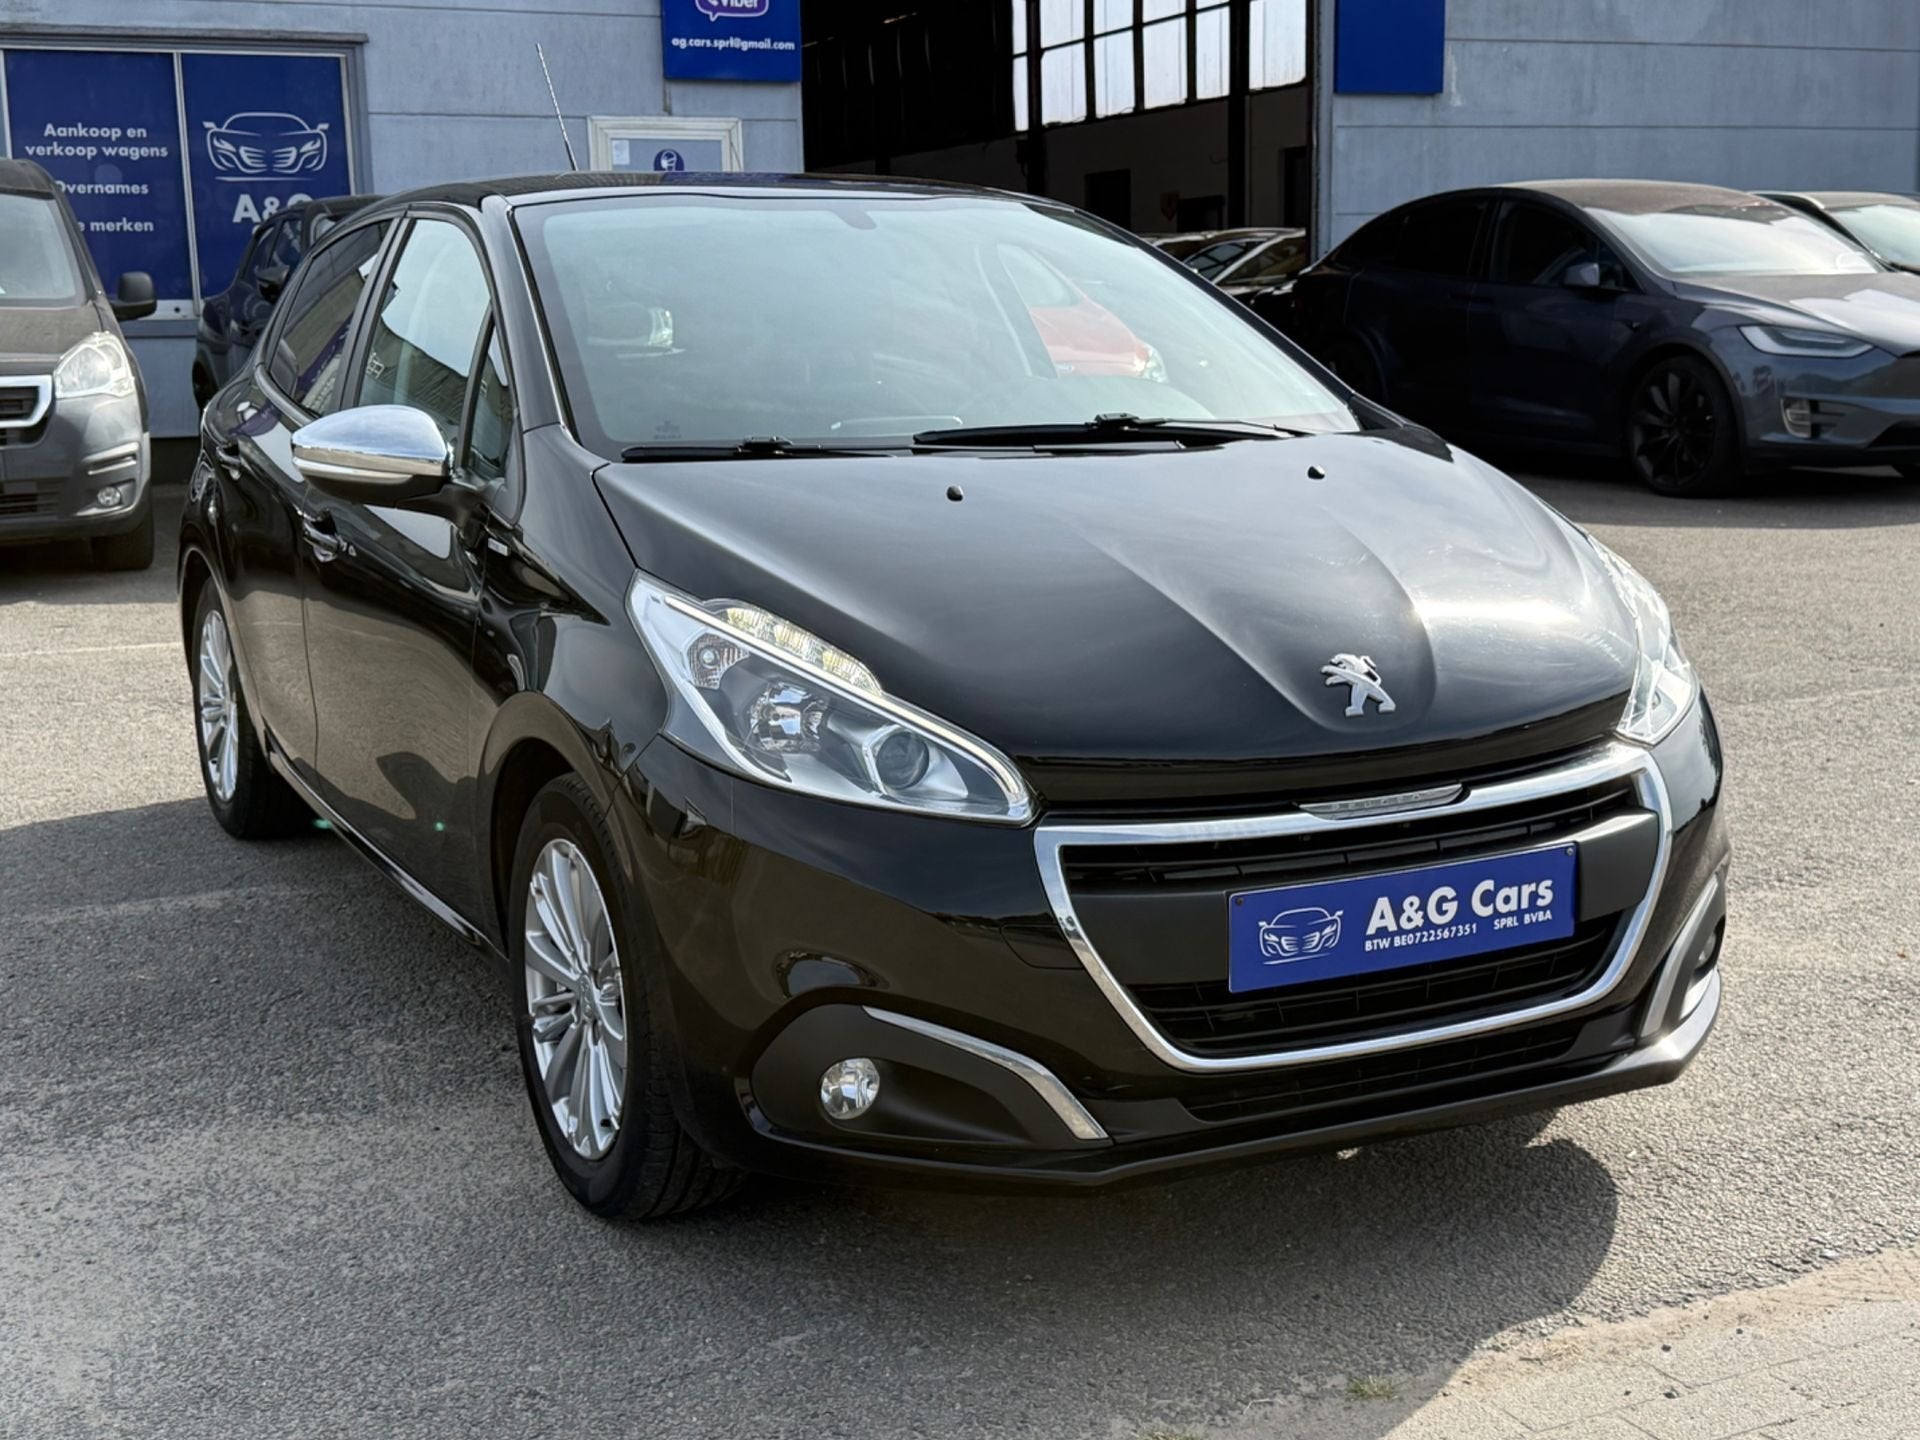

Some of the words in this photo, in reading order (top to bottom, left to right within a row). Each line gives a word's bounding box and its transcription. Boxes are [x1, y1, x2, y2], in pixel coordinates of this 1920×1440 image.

[671, 36, 795, 51] ag.cars.sprl@gmail.com
[44, 122, 122, 141] Aankoop
[126, 127, 147, 138] en
[25, 141, 97, 160] verkoop
[102, 146, 168, 160] wagens
[90, 217, 154, 232] merken
[1366, 886, 1459, 935] A&G
[1472, 879, 1554, 917] Cars
[1365, 938, 1391, 951] BTW
[1393, 923, 1477, 947] BE0722567351
[1494, 917, 1519, 930] SPRL
[1524, 910, 1552, 924] BVBA
